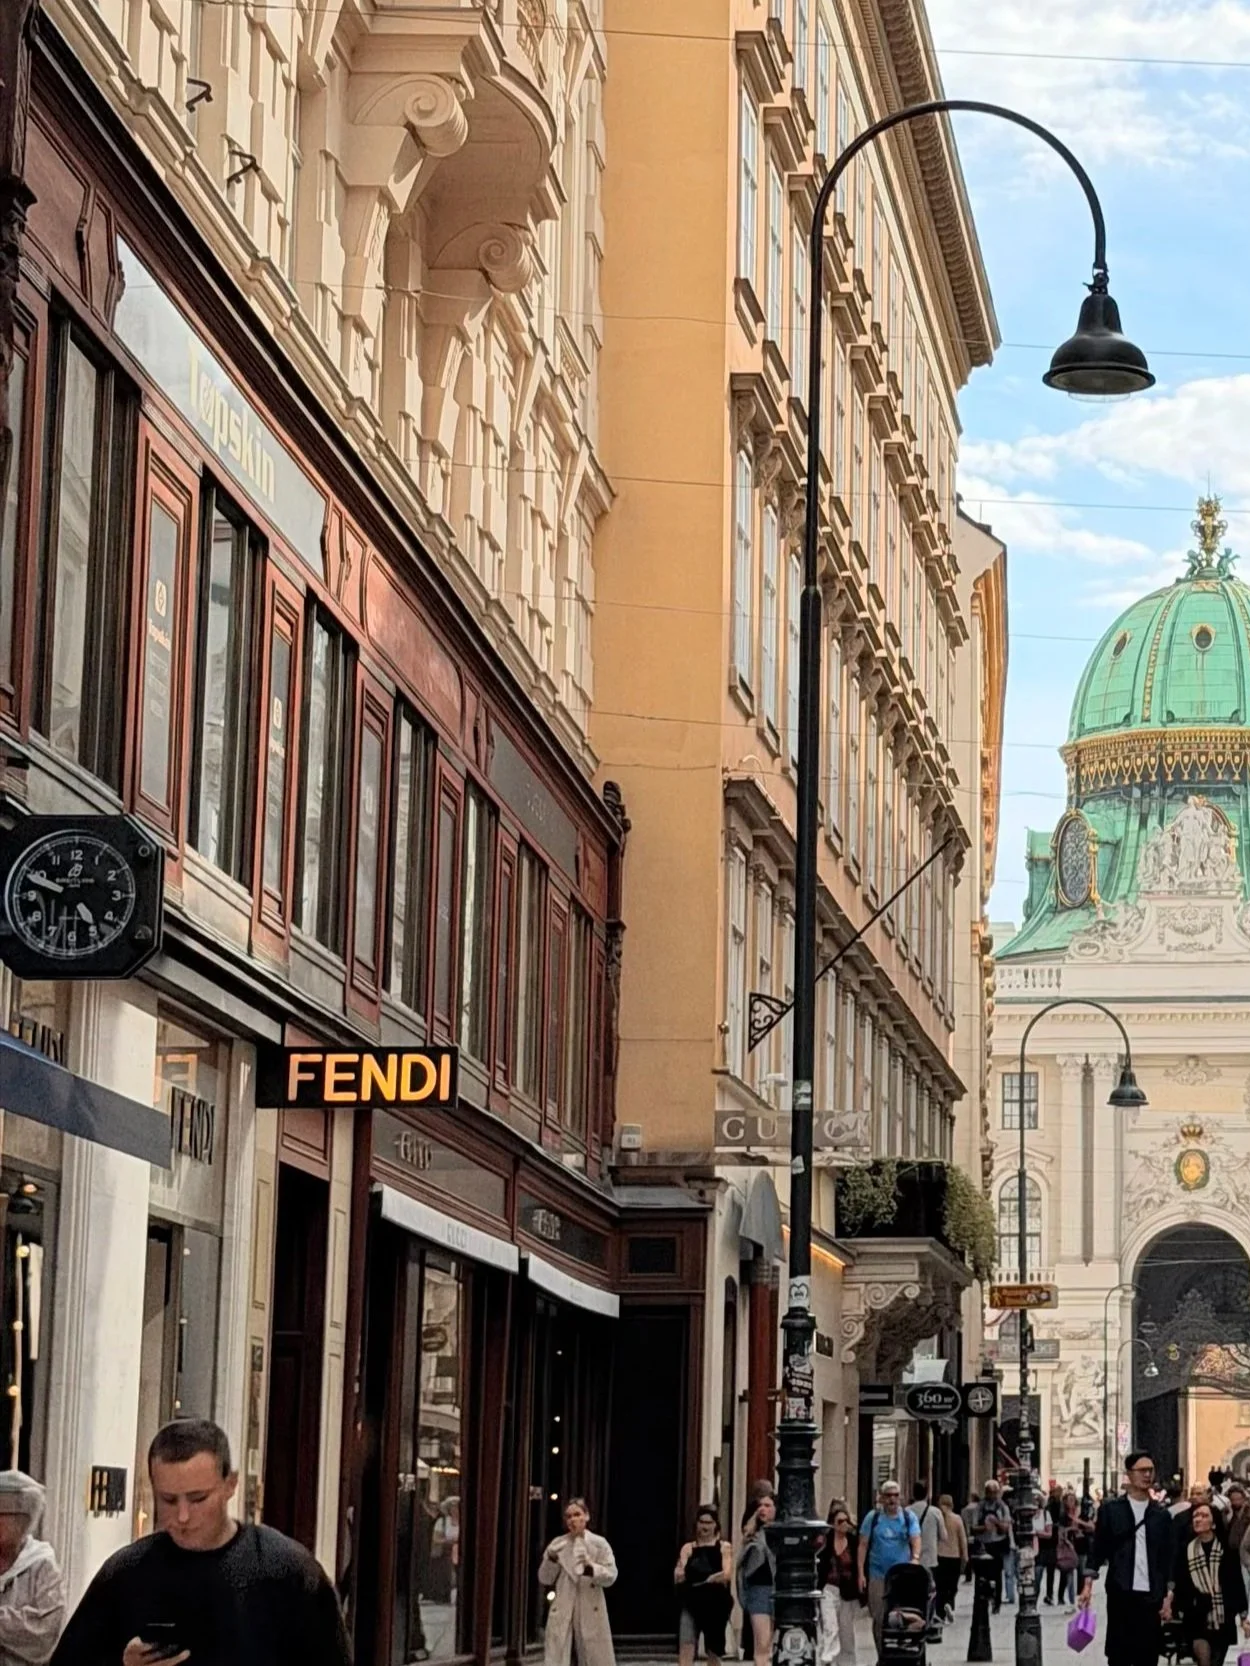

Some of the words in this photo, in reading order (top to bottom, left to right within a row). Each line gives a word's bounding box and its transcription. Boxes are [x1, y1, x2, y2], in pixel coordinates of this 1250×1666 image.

[188, 335, 275, 503] Topskin
[52, 855, 60, 865] 11
[71, 850, 84, 861] 12
[107, 870, 117, 881] 2
[27, 890, 37, 901] 9
[112, 890, 121, 901] 3
[32, 910, 42, 922] 8
[104, 911, 114, 921] 4
[48, 926, 57, 937] 7
[67, 931, 77, 942] 6
[88, 925, 98, 937] 5
[287, 1053, 451, 1101] FENDI
[915, 1389, 942, 1408] 360
